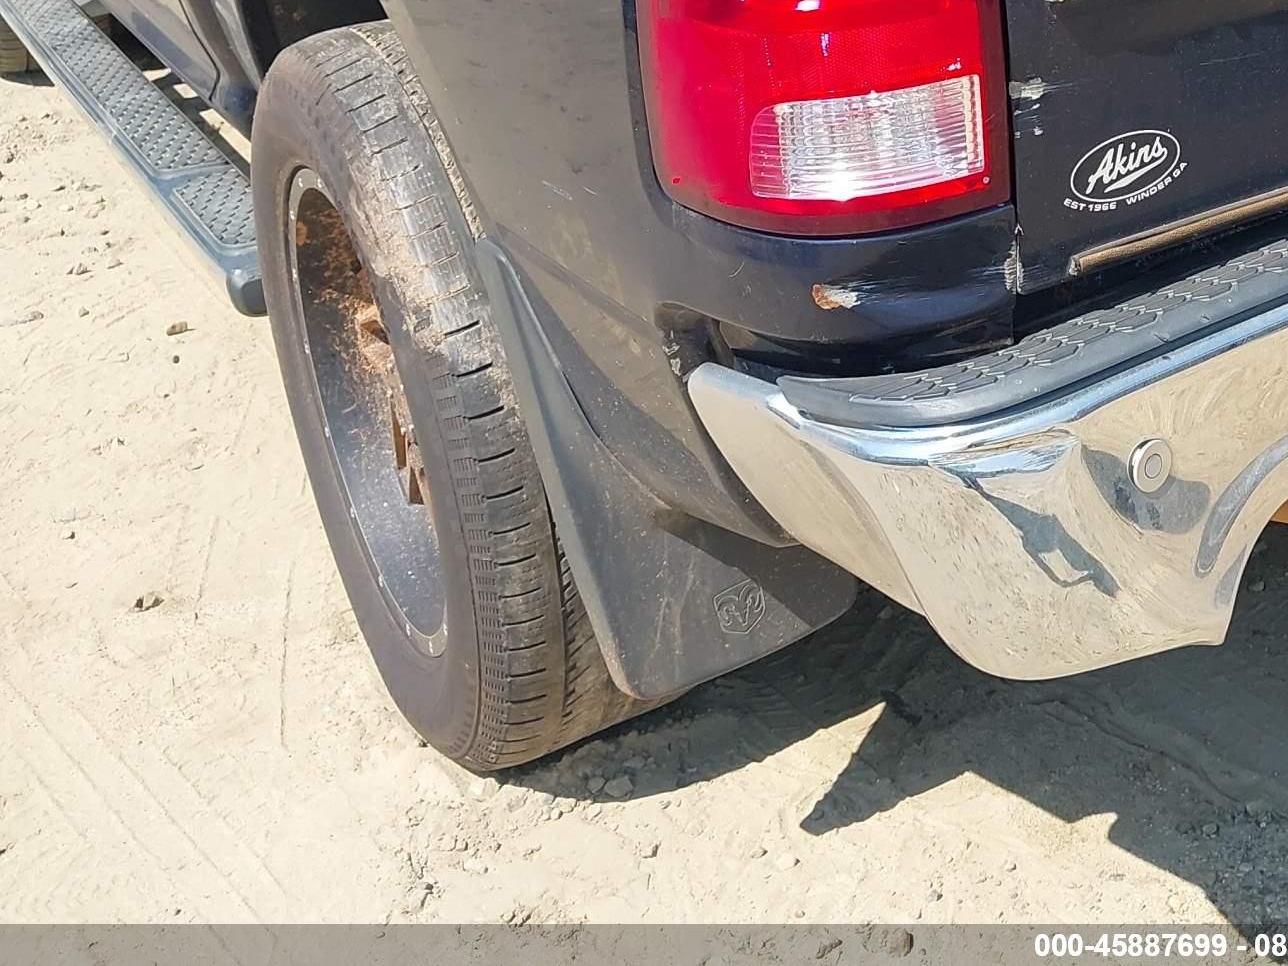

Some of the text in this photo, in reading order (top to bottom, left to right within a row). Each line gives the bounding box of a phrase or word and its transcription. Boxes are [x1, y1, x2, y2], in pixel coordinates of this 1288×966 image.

[1063, 162, 1188, 212] EST 1966 WINDER GA
[1085, 136, 1168, 195] Akins
